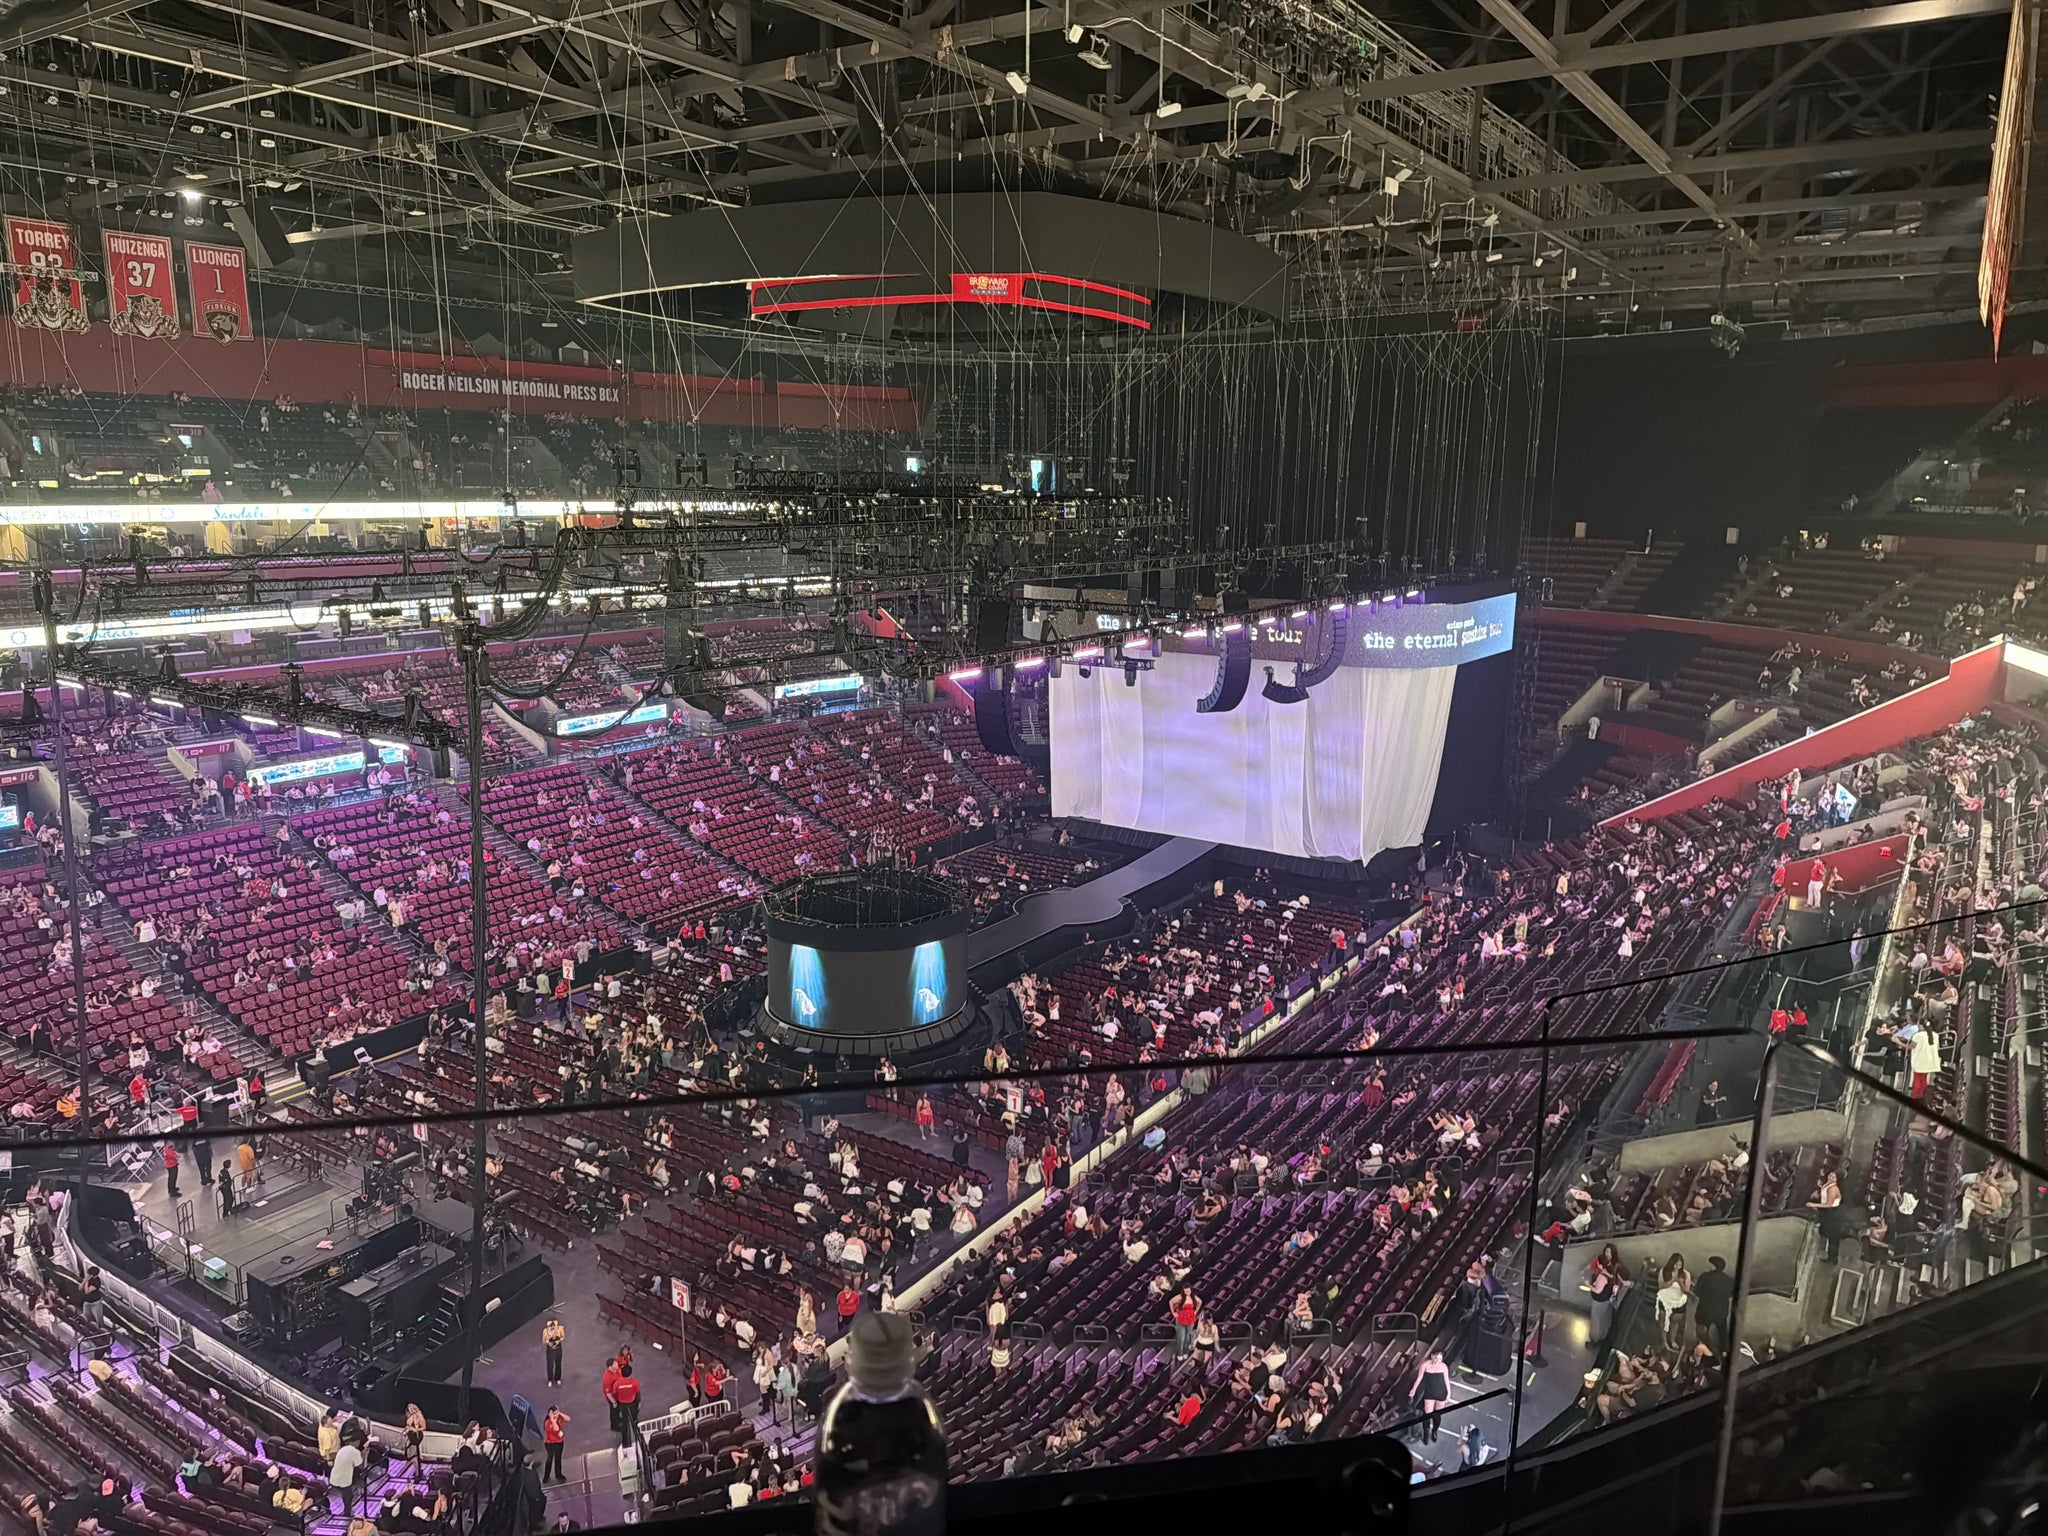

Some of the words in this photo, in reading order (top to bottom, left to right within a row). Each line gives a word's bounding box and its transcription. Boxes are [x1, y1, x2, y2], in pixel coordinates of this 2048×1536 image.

[15, 228, 70, 250] TORREY
[110, 237, 166, 258] HUIZENGA
[192, 248, 240, 268] LUONGO
[127, 261, 156, 288] 37
[213, 268, 225, 294] 1
[206, 303, 237, 314] FLORIDA
[403, 372, 445, 391] ROGER
[447, 374, 499, 395] NEILSON
[501, 379, 561, 398] MEMORIAL
[563, 385, 597, 402] PRESS
[599, 387, 619, 403] BOX
[1097, 614, 1120, 630] the
[1266, 626, 1302, 644] tour
[1364, 633, 1395, 649] the
[1404, 629, 1458, 649] eternal
[219, 743, 230, 753] 117
[20, 772, 36, 782] 116
[677, 1291, 685, 1308] 3
